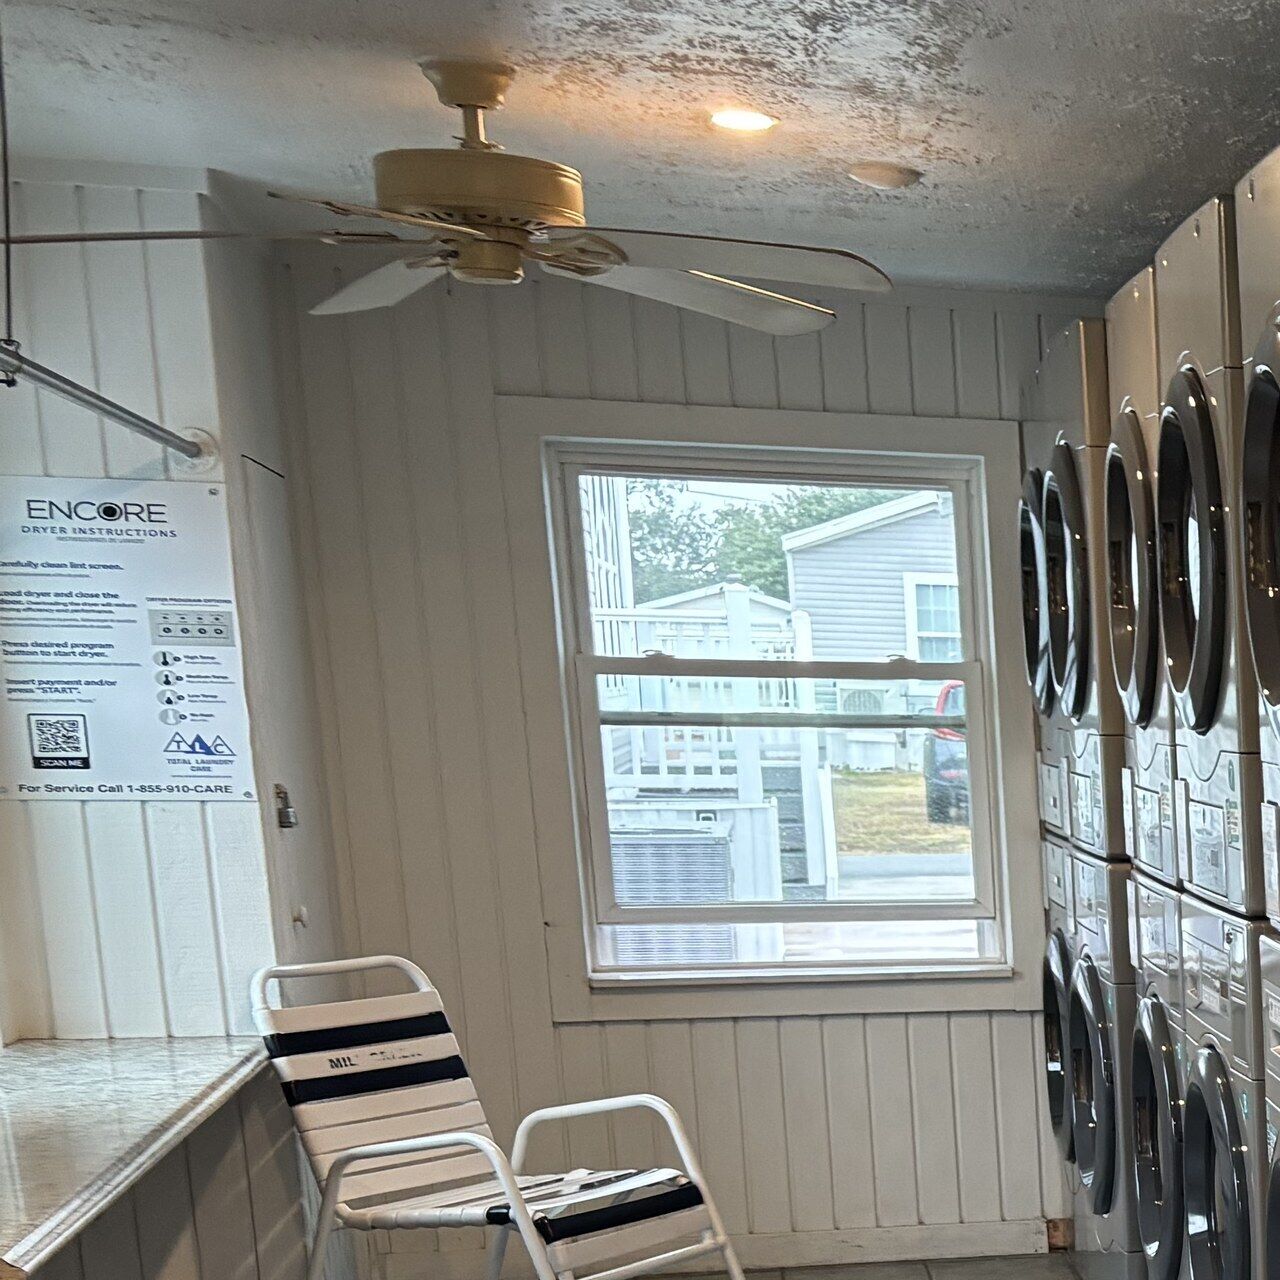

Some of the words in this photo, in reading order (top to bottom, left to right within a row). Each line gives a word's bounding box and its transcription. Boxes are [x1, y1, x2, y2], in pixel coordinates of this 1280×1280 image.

[26, 499, 169, 524] ENCORE
[21, 525, 67, 535] DRYER
[72, 527, 178, 538] INSTRUCTIONS
[40, 561, 68, 569] clean
[69, 561, 88, 570] lint
[24, 590, 51, 599] dryer
[53, 590, 73, 598] and
[75, 591, 100, 599] close
[101, 591, 120, 600] the
[30, 640, 68, 649] desired
[70, 641, 115, 651] program
[40, 649, 51, 657] to
[37, 679, 82, 687] payment
[83, 679, 118, 687] and/or
[40, 758, 67, 767] SCAN
[68, 759, 84, 768] ME
[18, 783, 40, 793] For
[44, 783, 93, 794] Service
[97, 784, 124, 793] Call
[127, 784, 234, 795] 1-855-910-CARE
